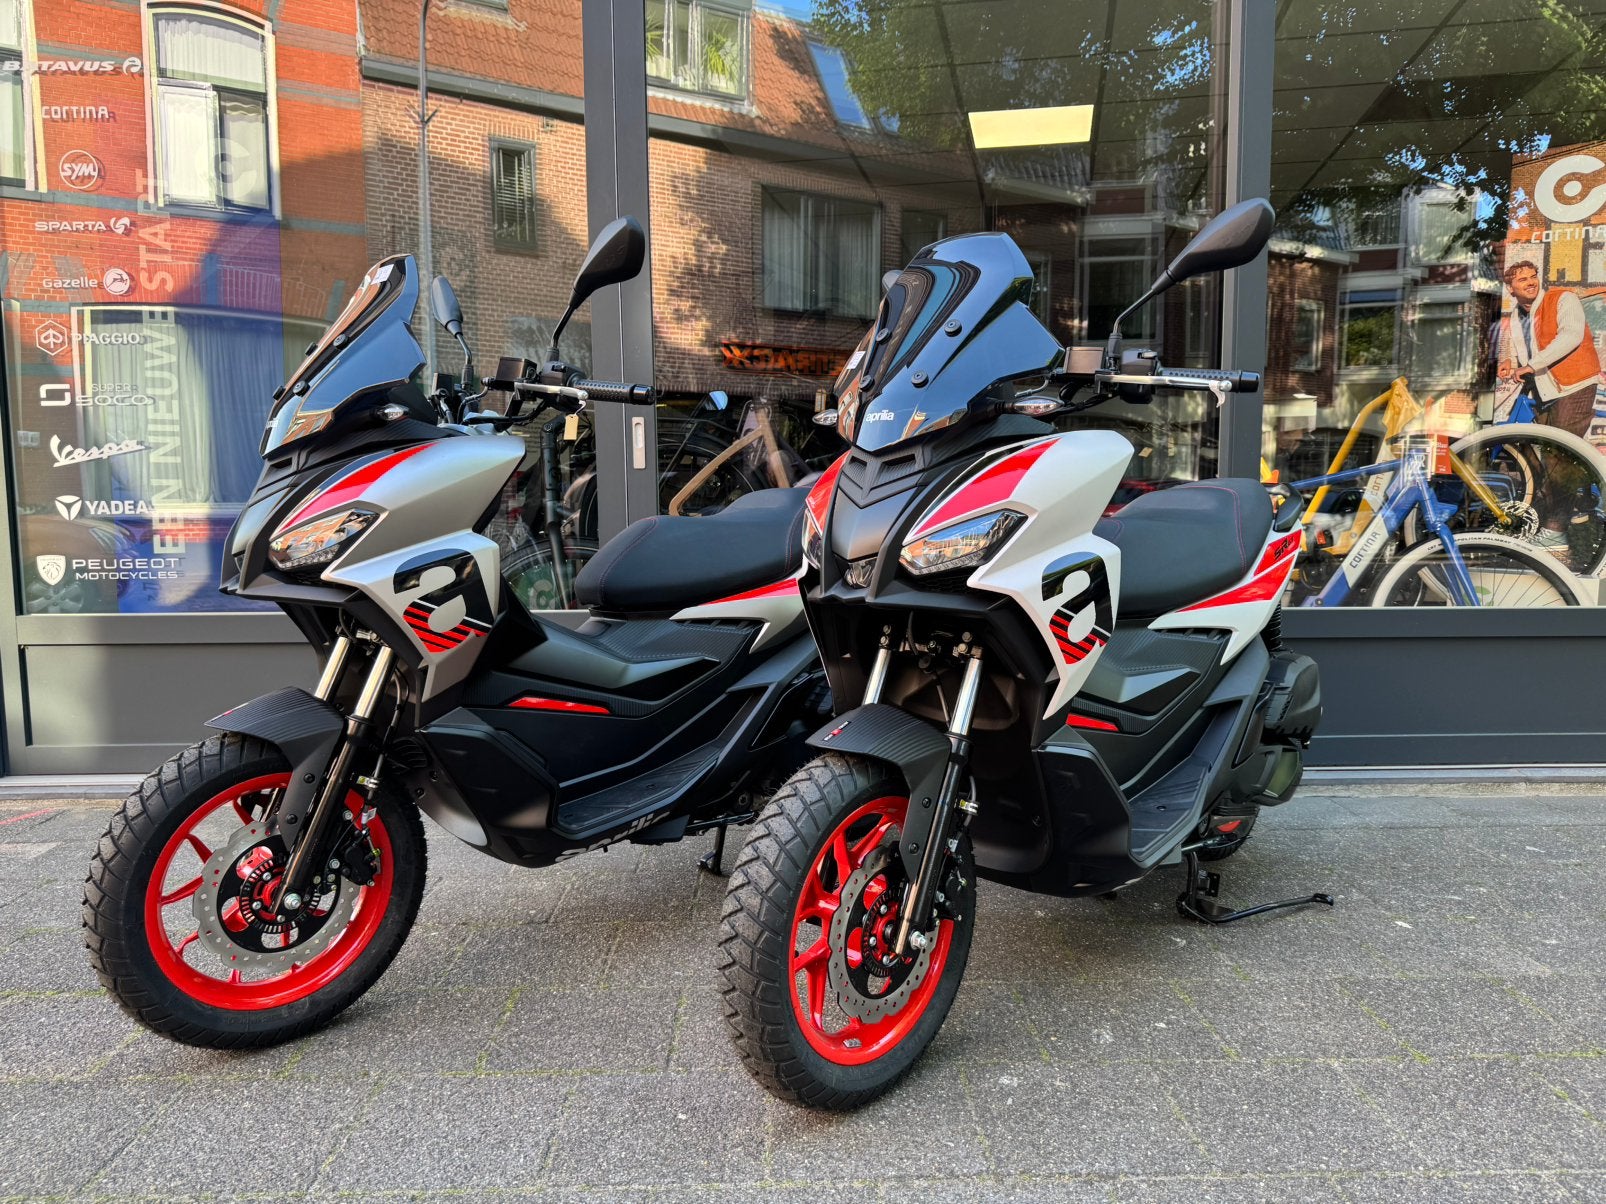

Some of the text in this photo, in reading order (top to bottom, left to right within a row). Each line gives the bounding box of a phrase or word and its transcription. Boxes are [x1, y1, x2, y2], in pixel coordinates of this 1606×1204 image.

[60, 162, 98, 180] SYM
[35, 221, 107, 231] SPARTA
[135, 168, 174, 293] START
[42, 278, 98, 289] Gazelle
[74, 332, 140, 345] PIAGGIO
[92, 383, 131, 392] SUPER
[142, 307, 181, 463] NIEUWE
[75, 395, 149, 406] SOCO
[865, 409, 895, 424] aprilia
[50, 434, 145, 467] Vespa
[85, 500, 150, 515] YADEA
[72, 558, 179, 570] PEUGEOT
